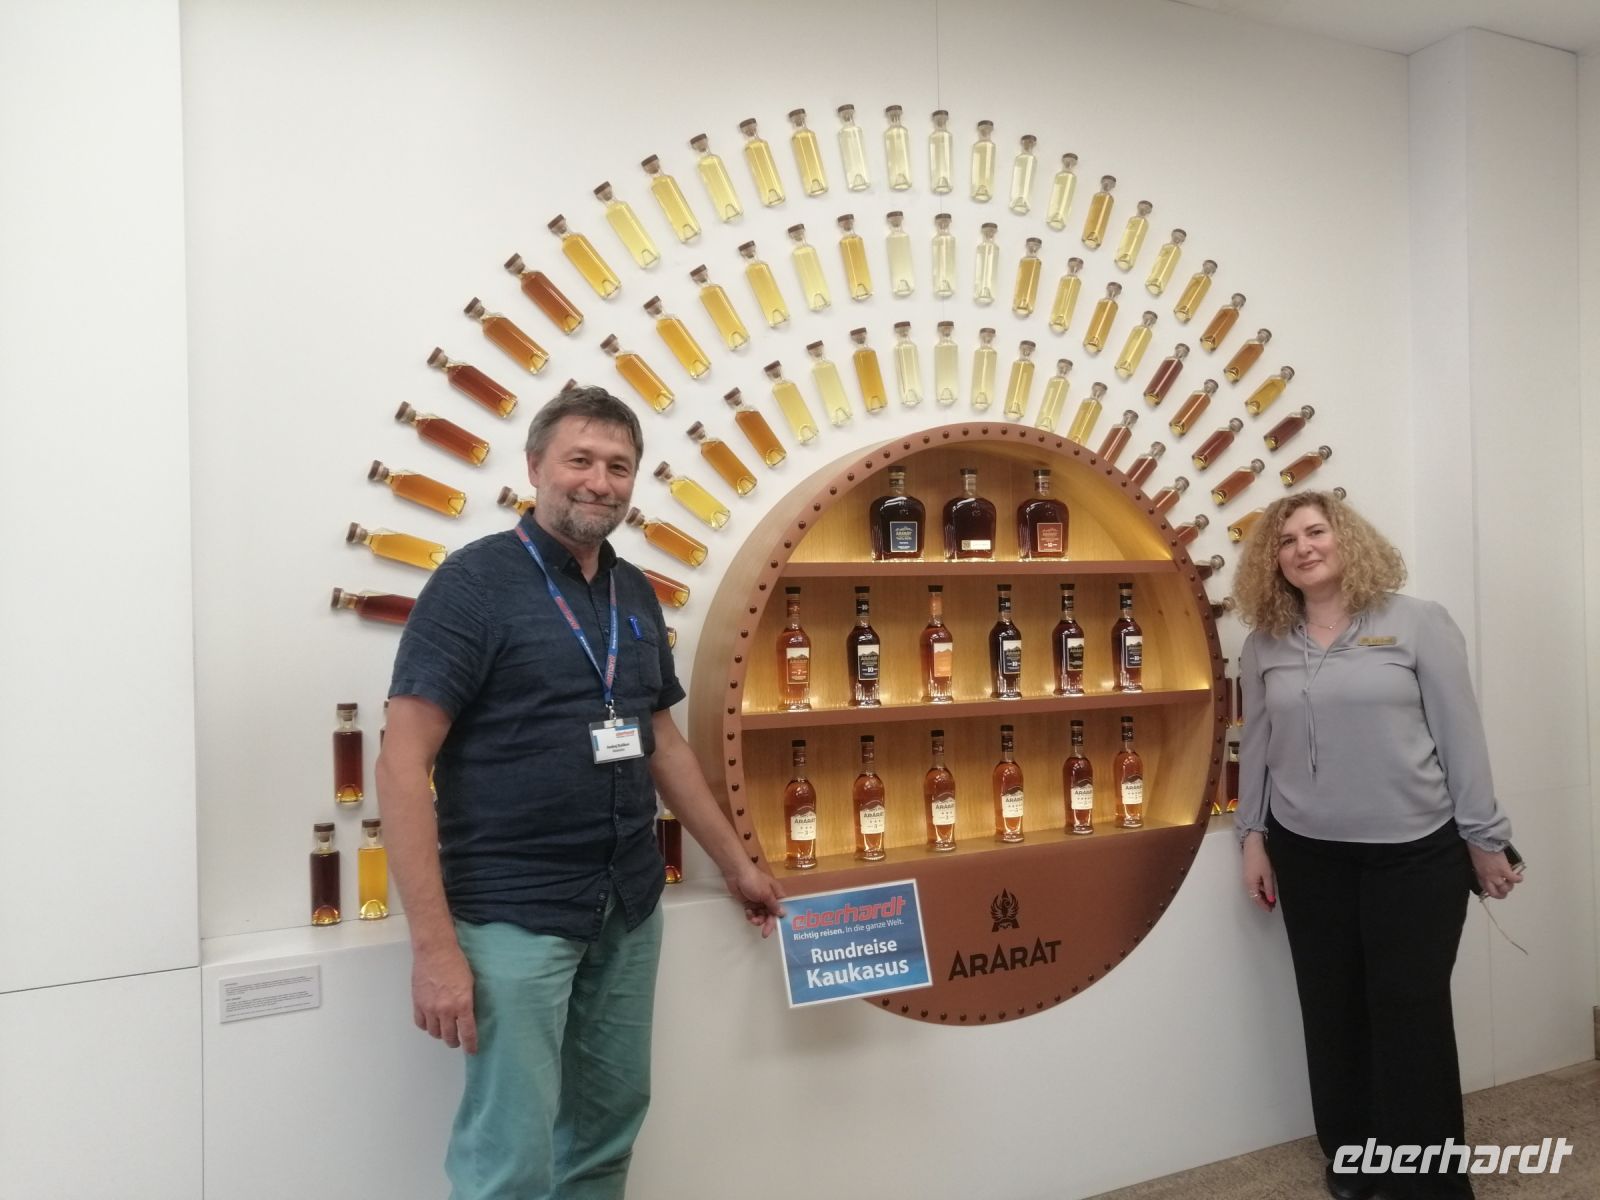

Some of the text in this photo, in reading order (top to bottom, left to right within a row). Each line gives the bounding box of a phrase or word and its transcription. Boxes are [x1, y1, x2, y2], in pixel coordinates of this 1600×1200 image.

[792, 896, 905, 930] eberhardt
[793, 930, 819, 941] Richtig
[819, 928, 845, 937] reisen.
[853, 924, 865, 933] die
[865, 921, 886, 932] ganze
[885, 918, 905, 928] Welt.
[810, 938, 898, 964] Rundreise
[948, 936, 1062, 981] ARARAT
[806, 959, 910, 989] Kaukasus
